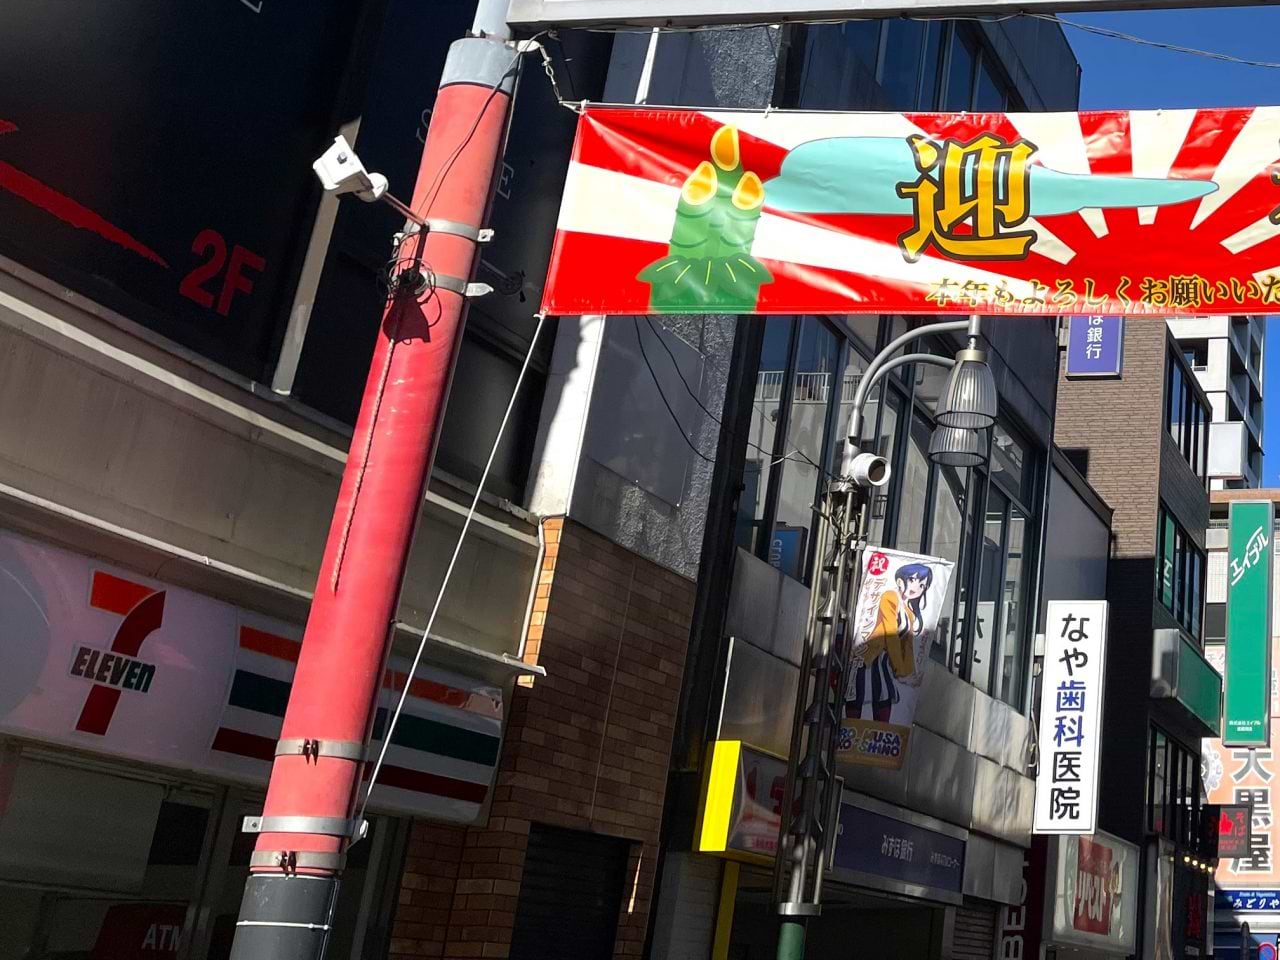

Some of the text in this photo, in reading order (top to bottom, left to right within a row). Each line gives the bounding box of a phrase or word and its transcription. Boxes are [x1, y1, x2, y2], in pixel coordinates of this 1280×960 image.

[179, 229, 266, 317] 2F
[1230, 525, 1269, 587] エイブル
[1048, 613, 1091, 821] なや歯科医院
